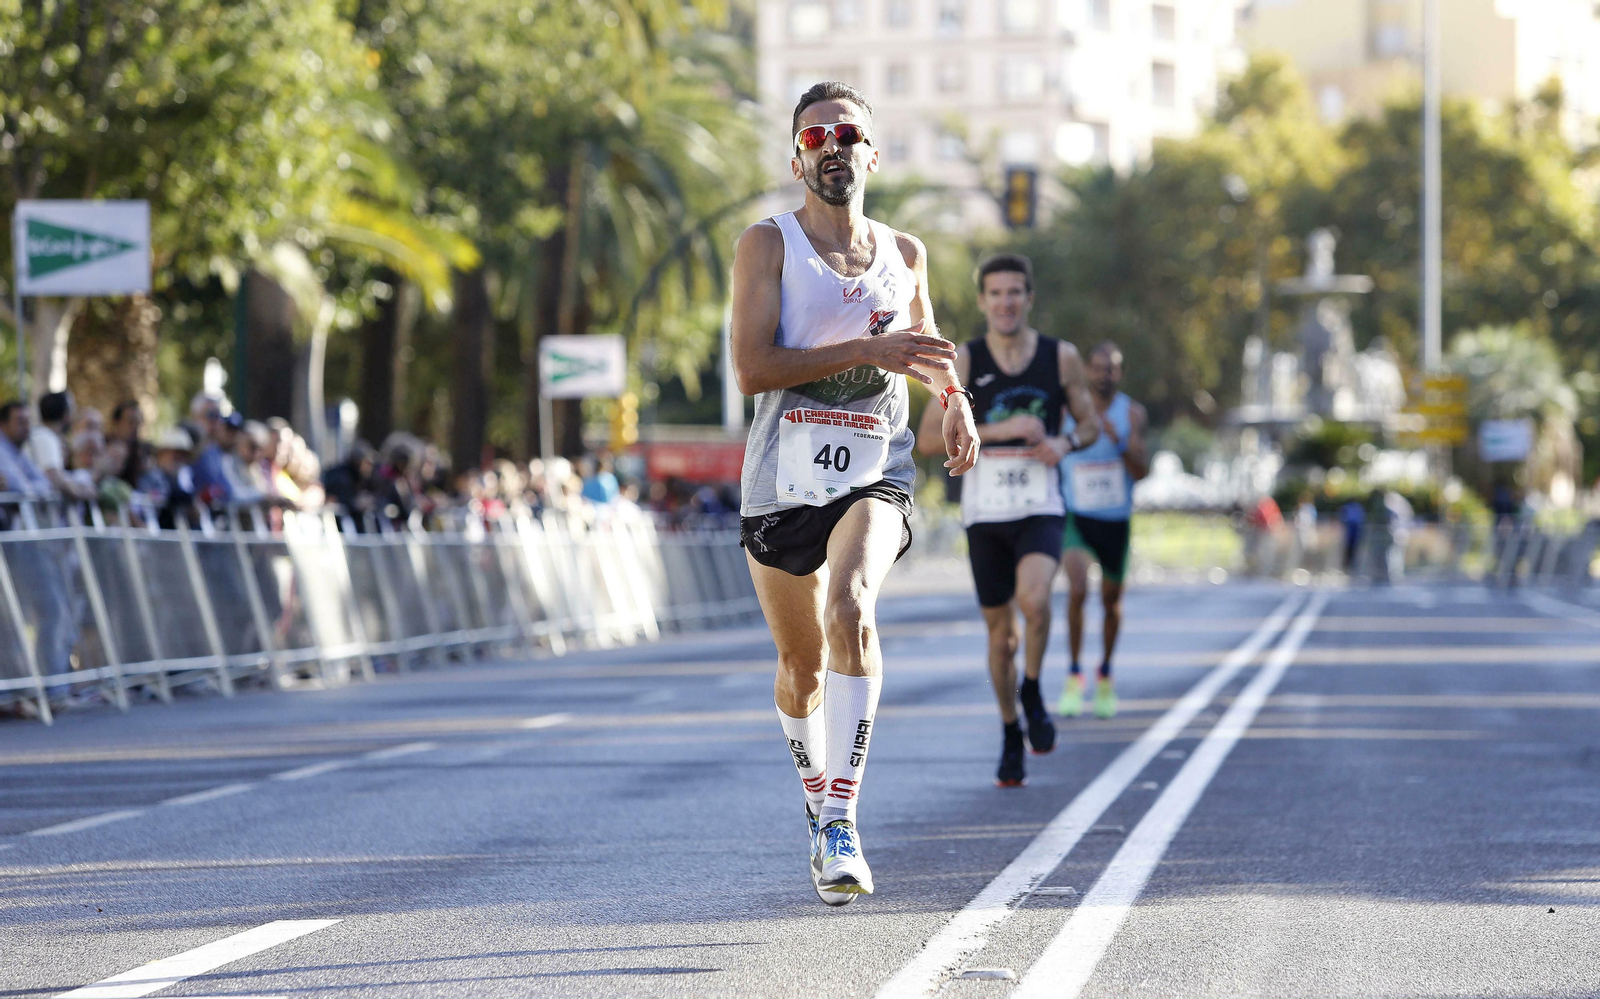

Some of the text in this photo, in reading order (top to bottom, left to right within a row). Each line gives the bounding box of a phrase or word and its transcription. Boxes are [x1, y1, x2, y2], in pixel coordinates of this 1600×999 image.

[784, 410, 803, 423] 41
[804, 410, 849, 420] CARRERA
[805, 417, 832, 425] CIUDAD
[833, 419, 843, 427] DE
[853, 432, 884, 441] FEDERADO
[813, 443, 851, 472] 40
